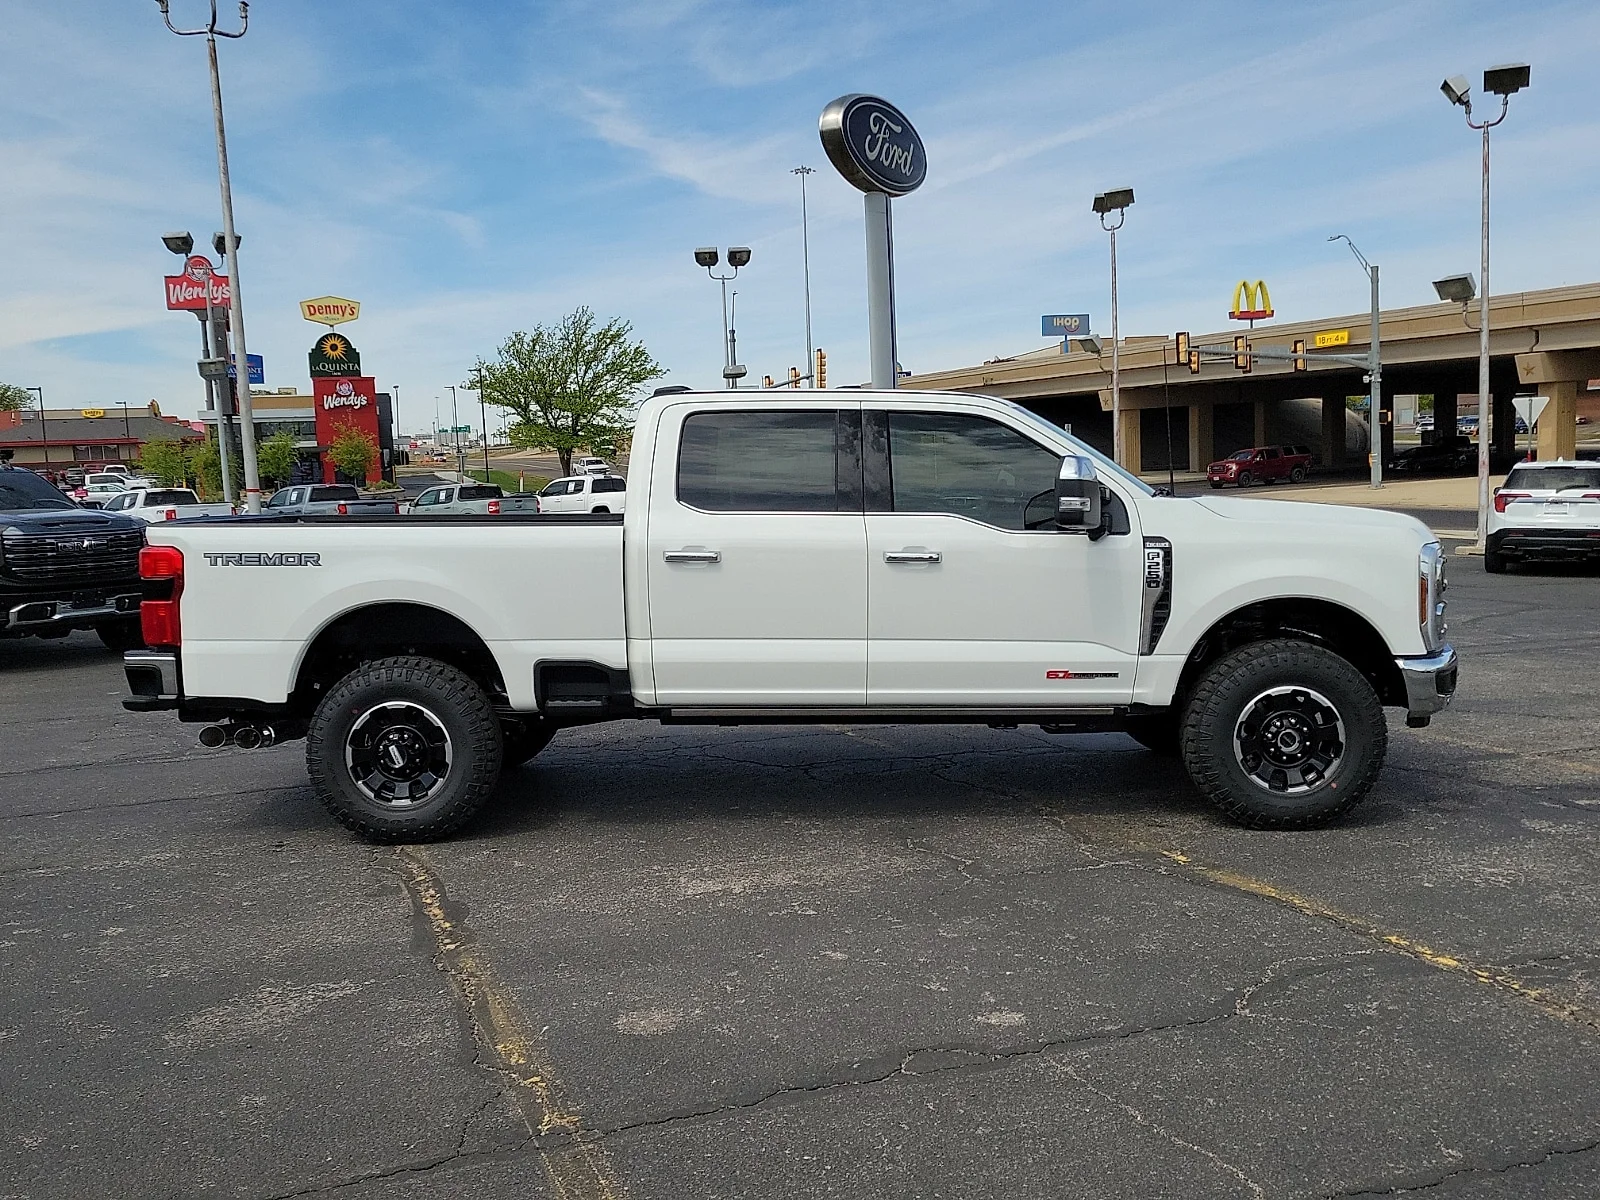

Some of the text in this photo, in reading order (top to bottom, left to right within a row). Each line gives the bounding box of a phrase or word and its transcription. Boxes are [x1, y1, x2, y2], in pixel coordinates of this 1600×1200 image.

[865, 112, 914, 176] Ford
[168, 279, 231, 304] Wendy's
[306, 303, 356, 317] Denny's
[1334, 334, 1340, 342] 4
[319, 362, 360, 373] QUINTA
[323, 392, 368, 410] Wendy's
[203, 553, 322, 566] TREMOR
